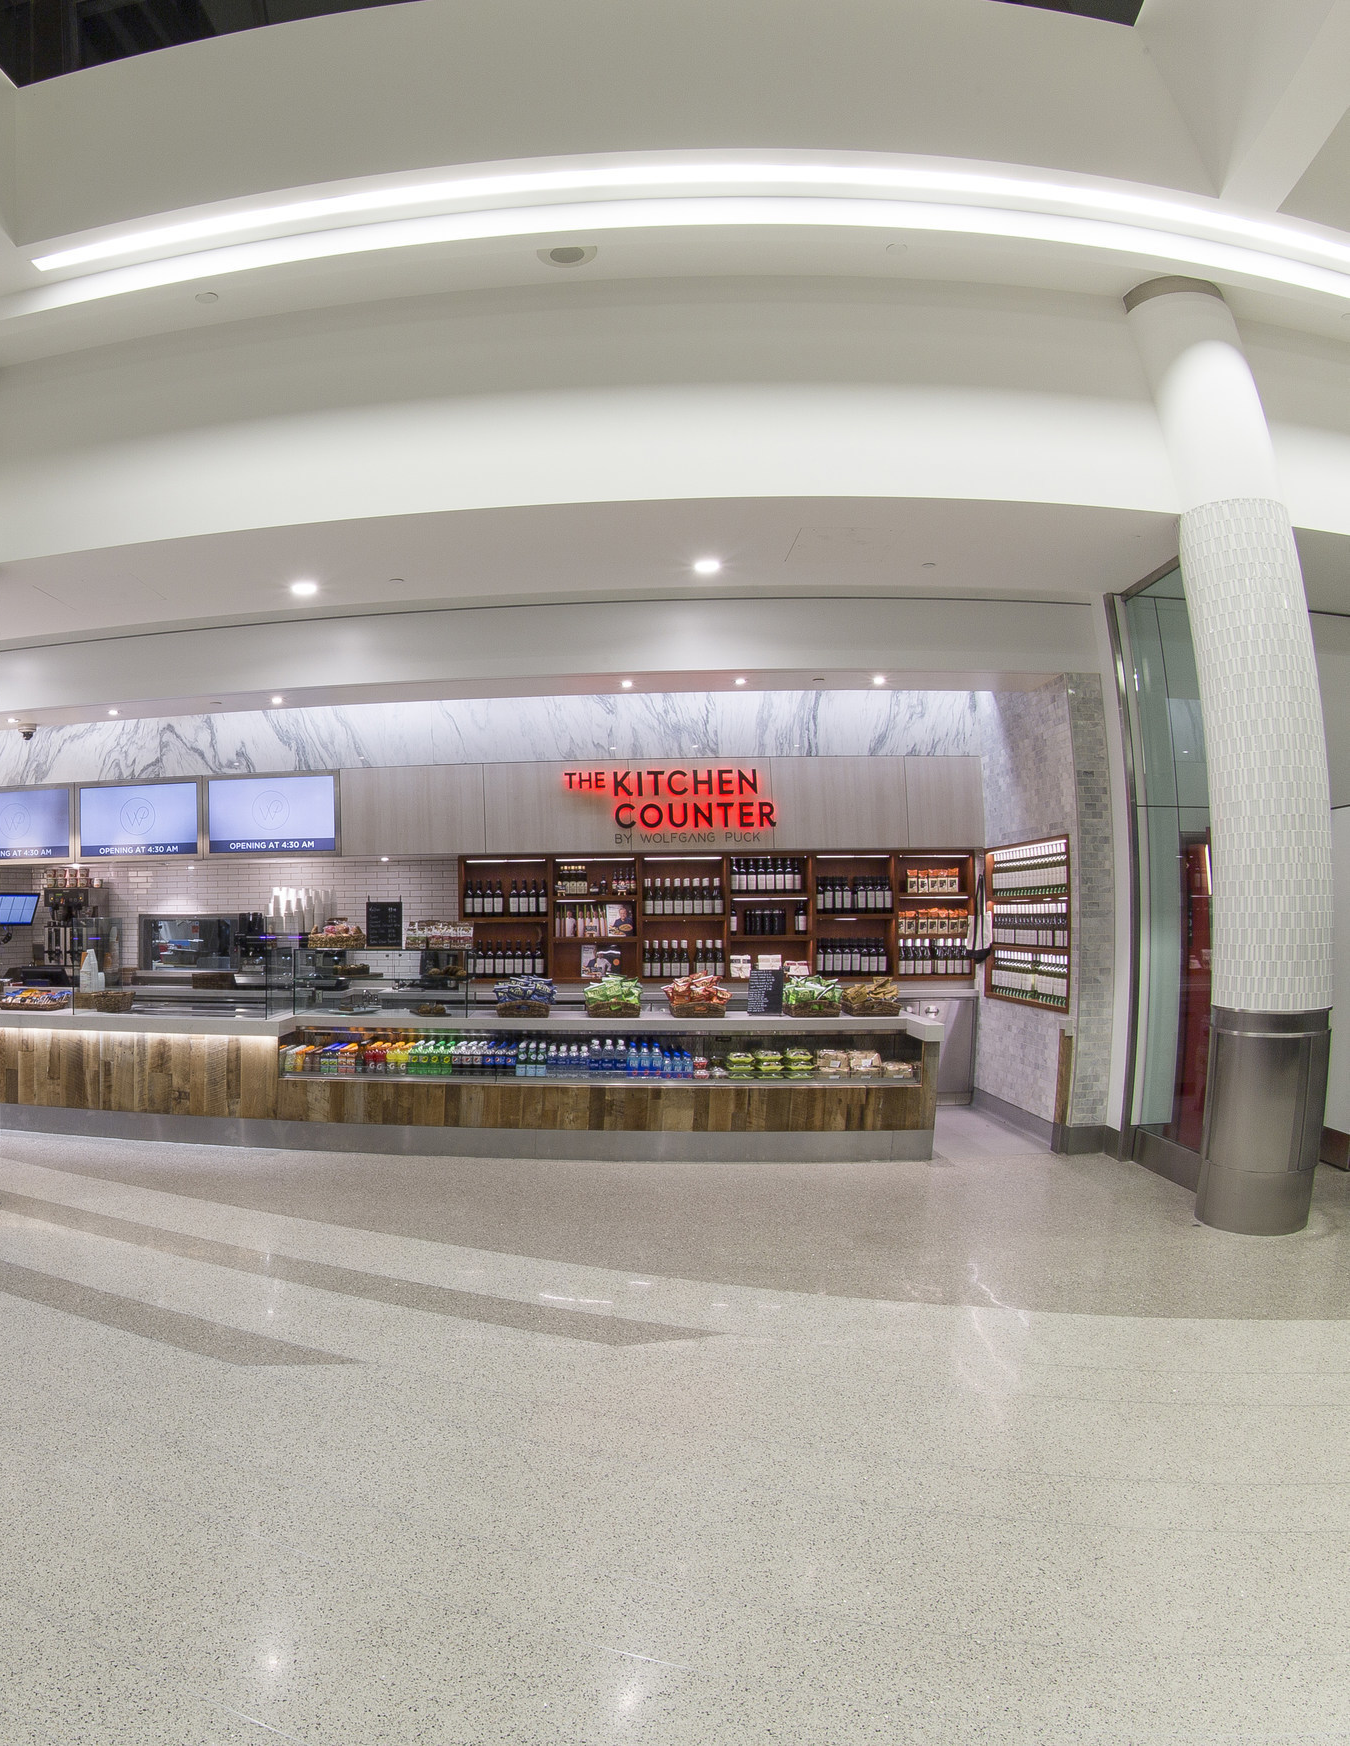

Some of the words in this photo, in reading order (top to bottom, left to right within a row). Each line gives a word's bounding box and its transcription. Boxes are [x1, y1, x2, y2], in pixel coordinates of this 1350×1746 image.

[564, 771, 606, 789] THE
[612, 768, 759, 797] KITCHEN
[614, 801, 777, 829] COUNTER
[614, 833, 633, 844] BY
[639, 832, 716, 844] WOLFGANG
[724, 831, 761, 843] PUCK
[99, 846, 134, 855] OPENING
[147, 845, 164, 853] 4:30
[229, 841, 267, 850] OPENING
[268, 841, 280, 849] AT
[281, 840, 300, 848] 4:30
[301, 840, 315, 848] AM
[12, 849, 22, 857] AT
[23, 848, 39, 856] 4:30
[40, 848, 52, 856] AM
